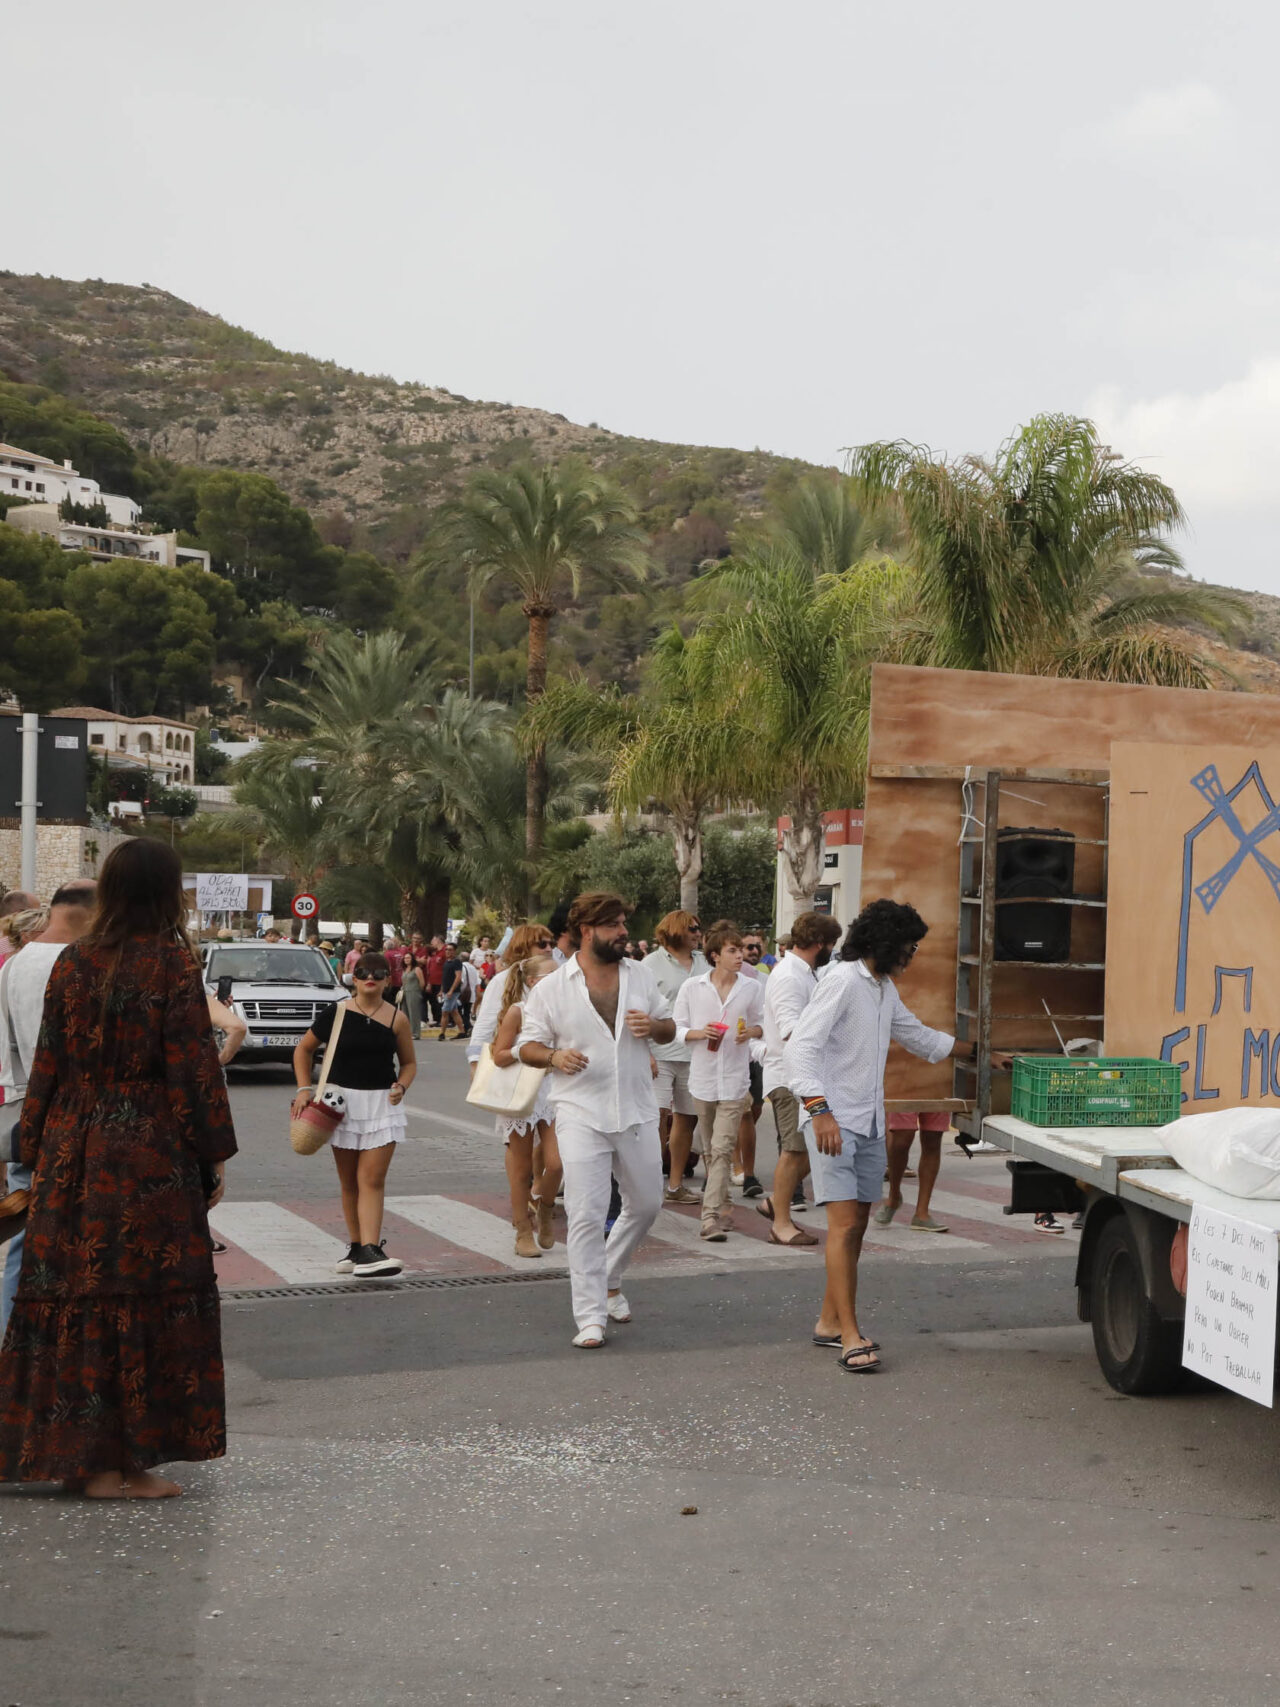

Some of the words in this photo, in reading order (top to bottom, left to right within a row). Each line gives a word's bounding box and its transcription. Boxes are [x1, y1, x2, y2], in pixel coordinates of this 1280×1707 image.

[297, 901, 313, 911] 30
[1160, 1024, 1220, 1104] EL
[1222, 1223, 1227, 1240] 7
